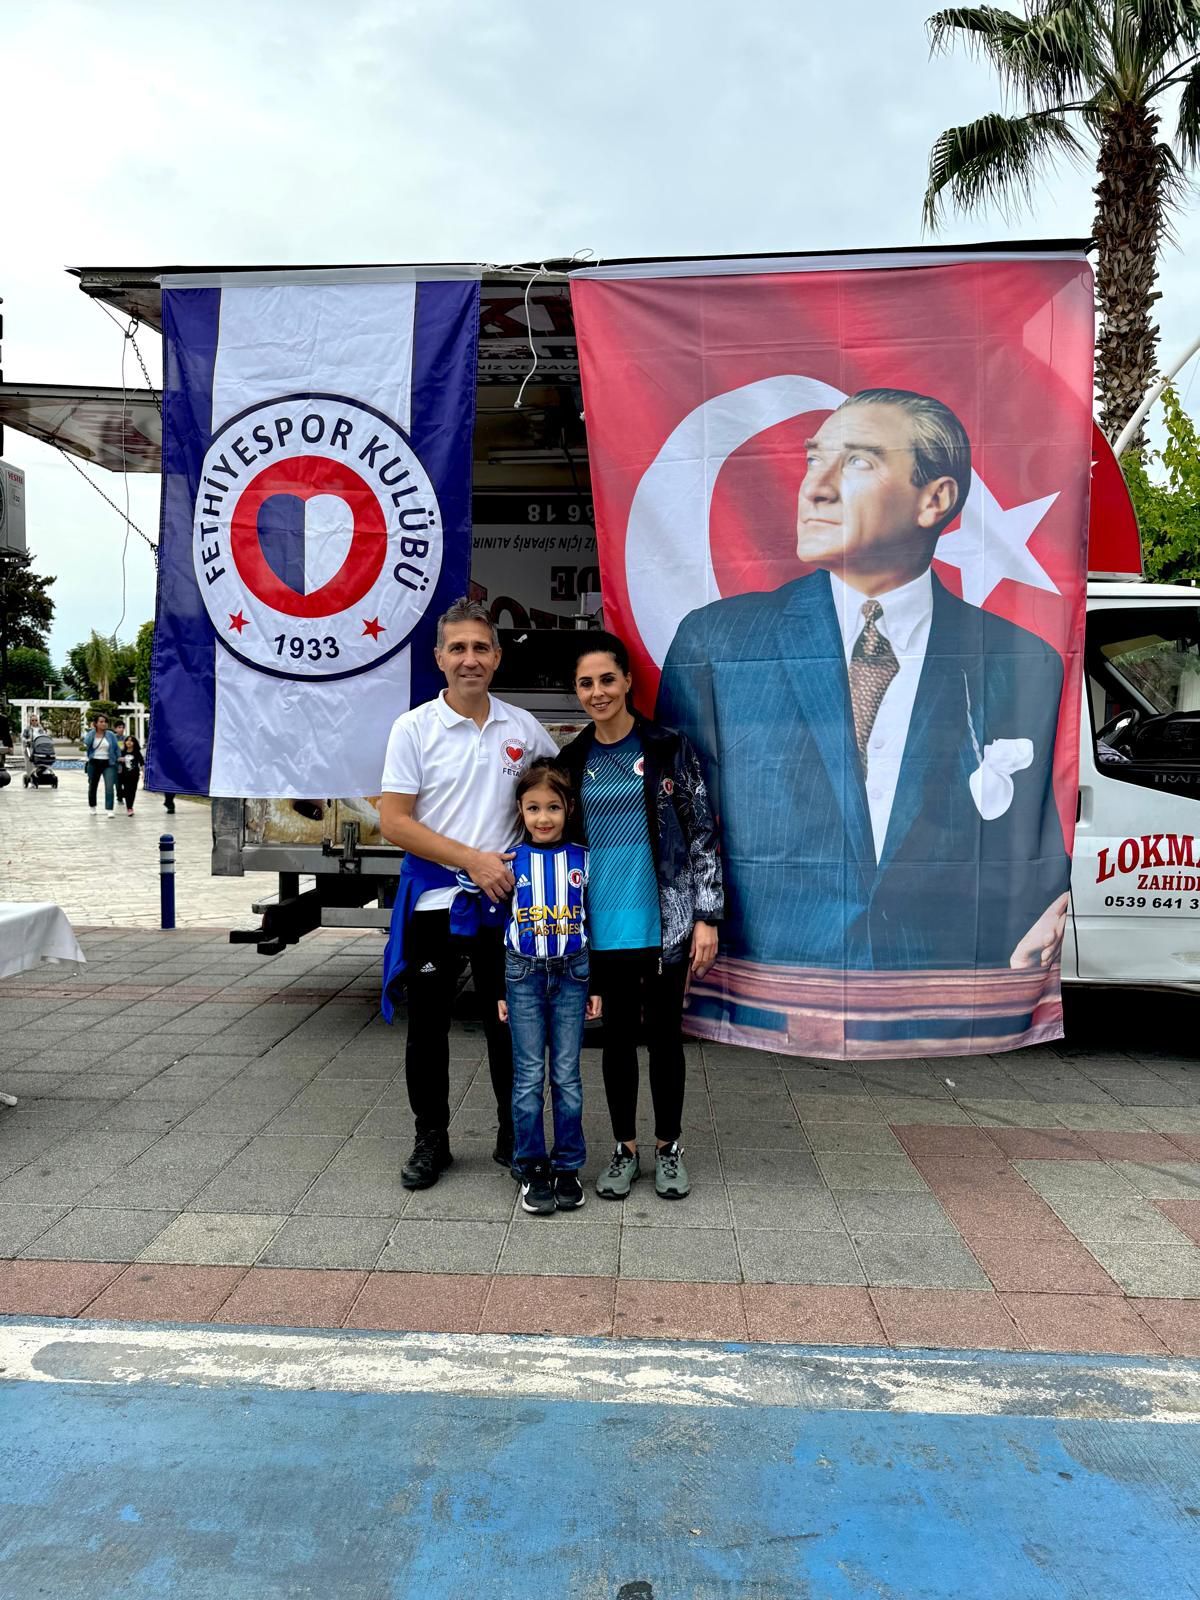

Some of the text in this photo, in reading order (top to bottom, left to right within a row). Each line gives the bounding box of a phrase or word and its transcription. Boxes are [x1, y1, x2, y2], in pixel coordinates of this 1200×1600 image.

[201, 414, 435, 591] FETHİYESPOR KULÜBÜ
[527, 504, 557, 522] 18
[473, 537, 511, 549] ALINIR
[513, 535, 556, 552] SİPARİŞ
[558, 535, 582, 552] İÇİN
[274, 634, 340, 661] 1933
[1104, 896, 1146, 908] 0539
[1152, 897, 1182, 909] 641
[517, 905, 581, 923] ESNAF
